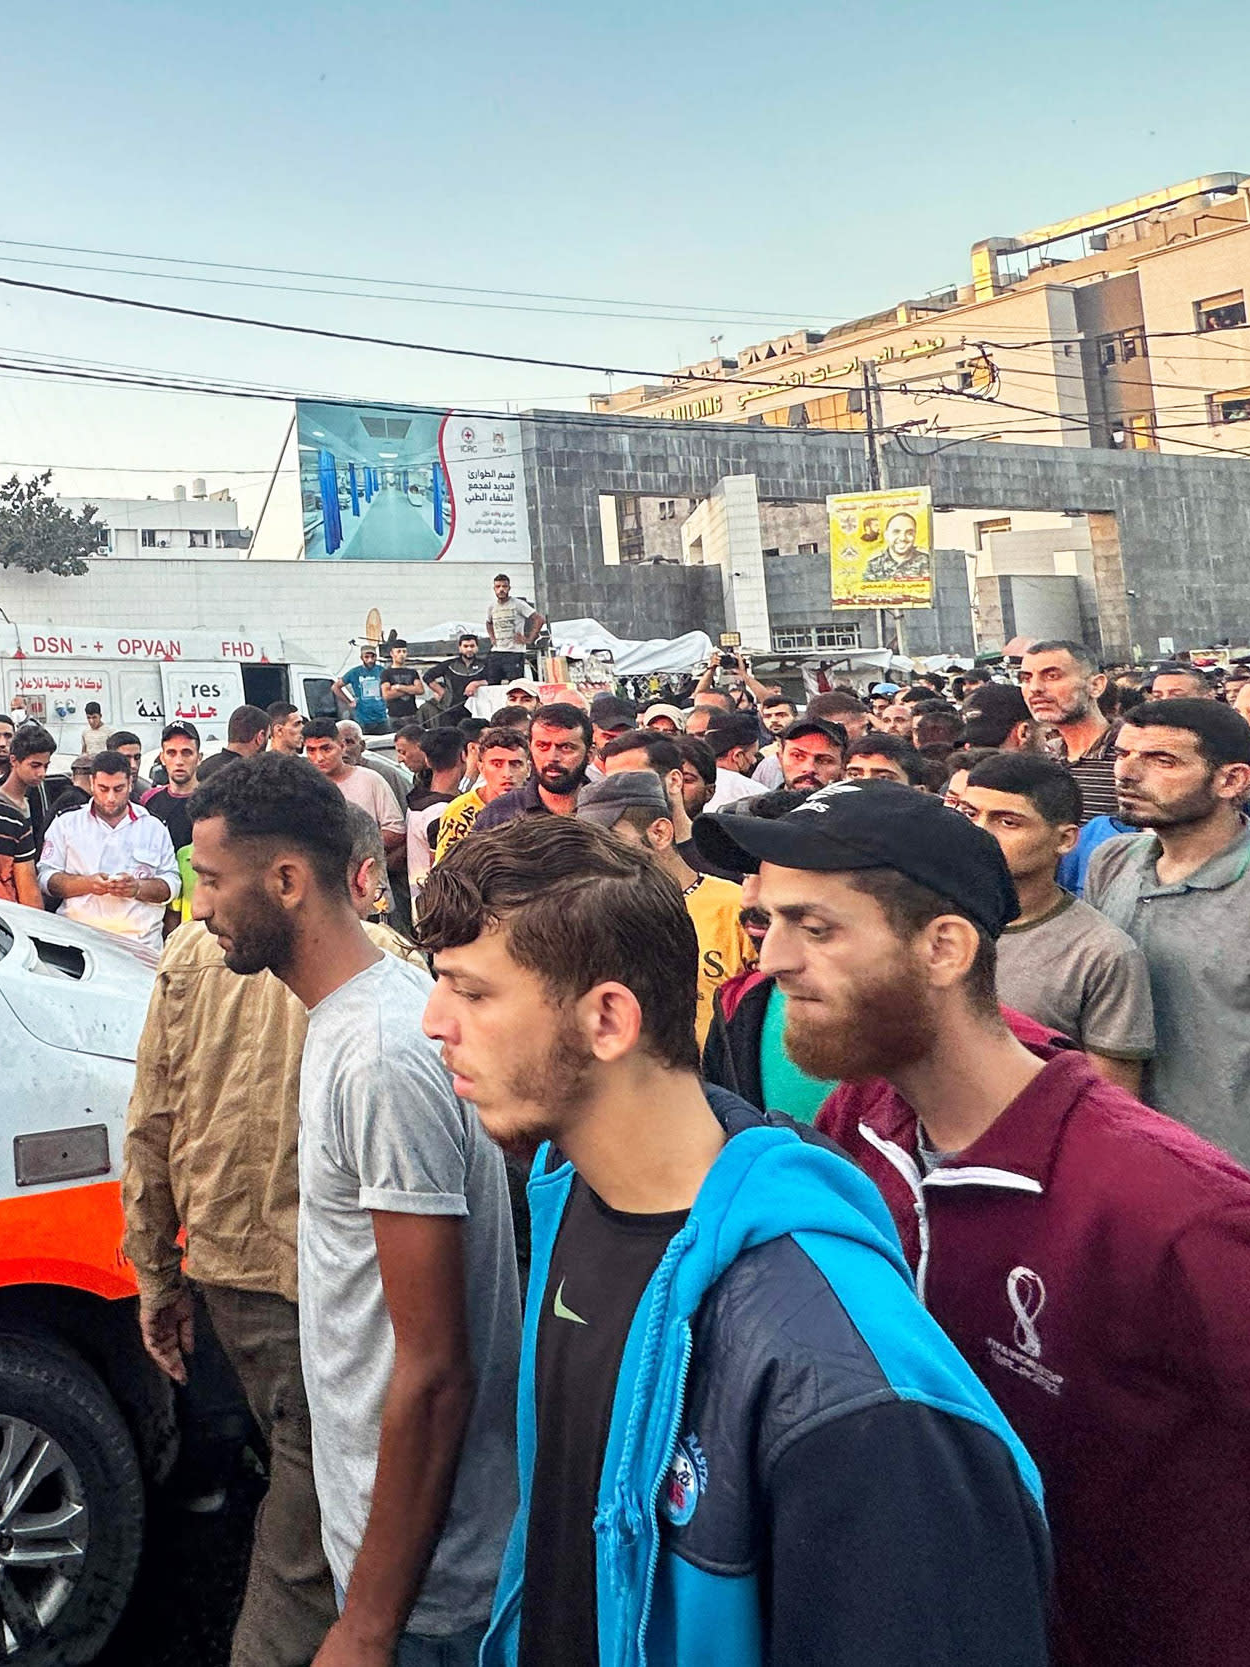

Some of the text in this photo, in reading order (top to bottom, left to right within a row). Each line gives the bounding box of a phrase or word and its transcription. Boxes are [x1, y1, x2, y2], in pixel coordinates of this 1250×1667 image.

[666, 395, 723, 420] BUILDING
[498, 470, 516, 480] قسم
[465, 492, 488, 505] الطبي
[33, 636, 73, 654] DSN
[117, 638, 182, 656] OPVAN
[221, 641, 255, 657] FHD
